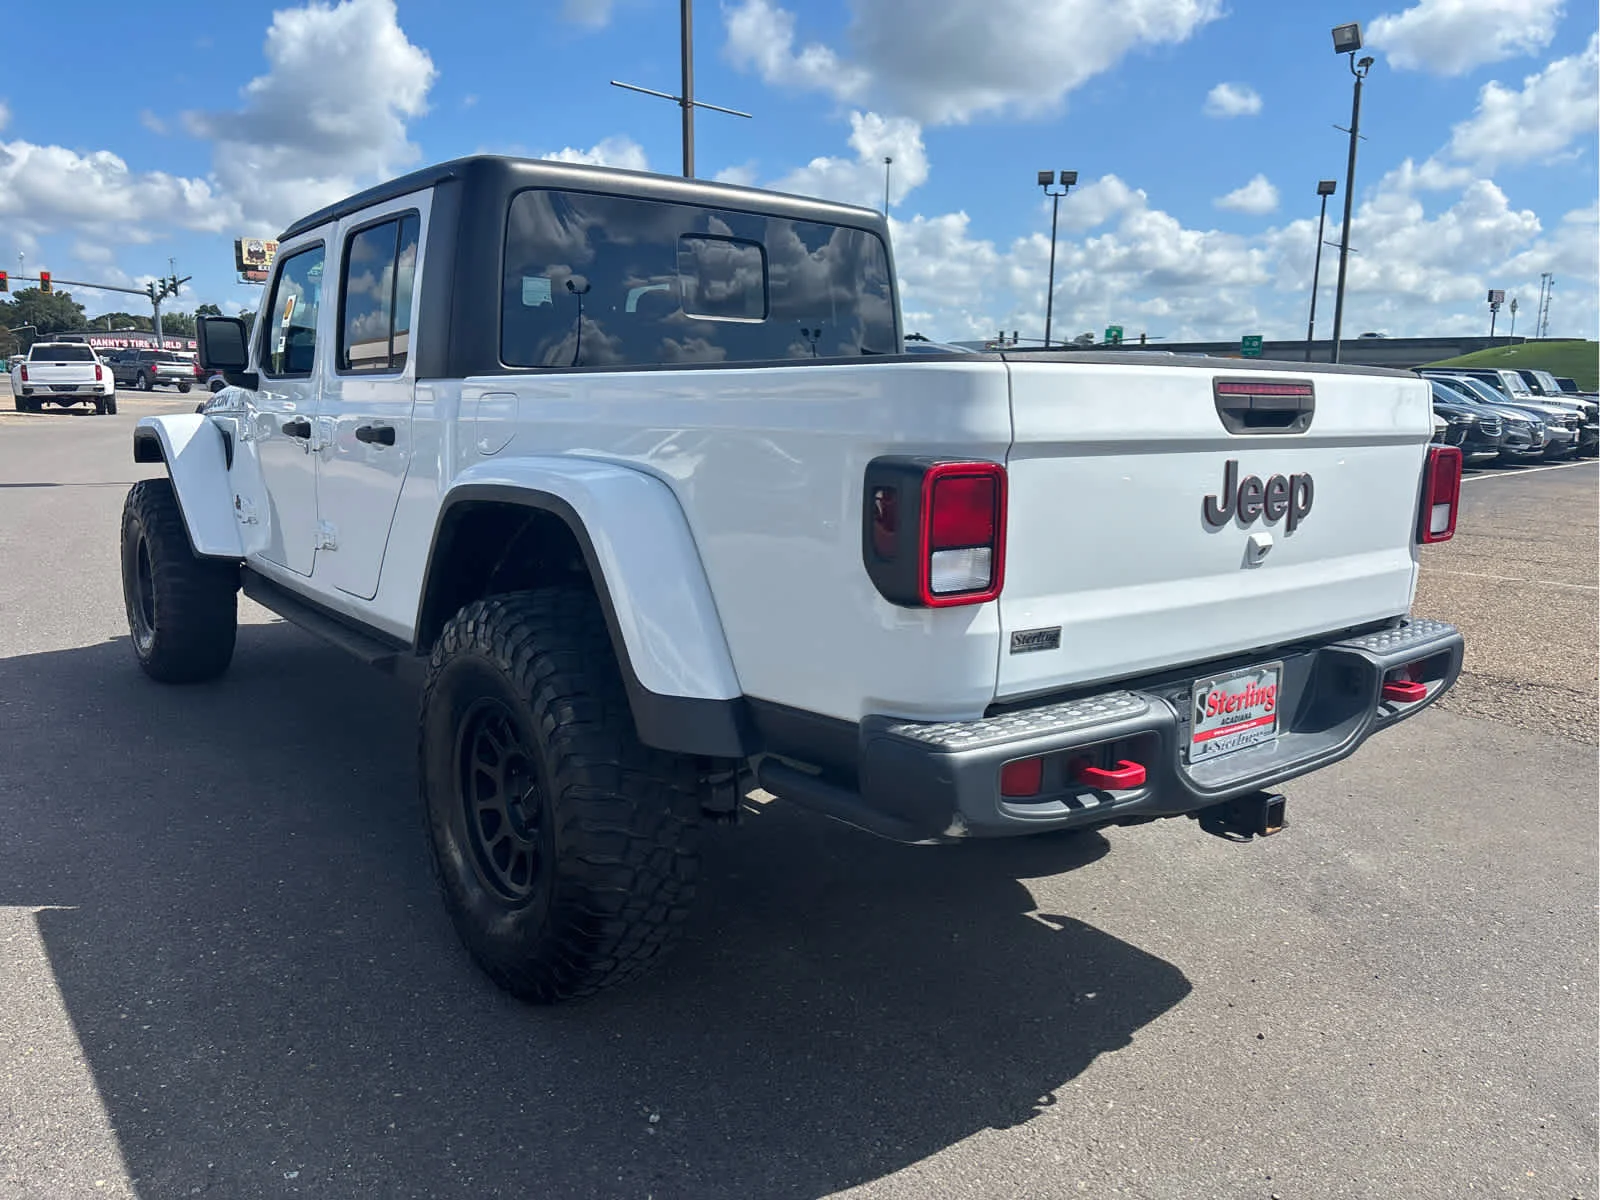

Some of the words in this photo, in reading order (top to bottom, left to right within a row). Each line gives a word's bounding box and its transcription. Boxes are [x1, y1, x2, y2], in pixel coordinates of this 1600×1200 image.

[90, 338, 128, 347] DANNY'S
[130, 339, 150, 348] TIRE
[1203, 459, 1314, 532] Jeep
[1206, 681, 1276, 717] Sterling
